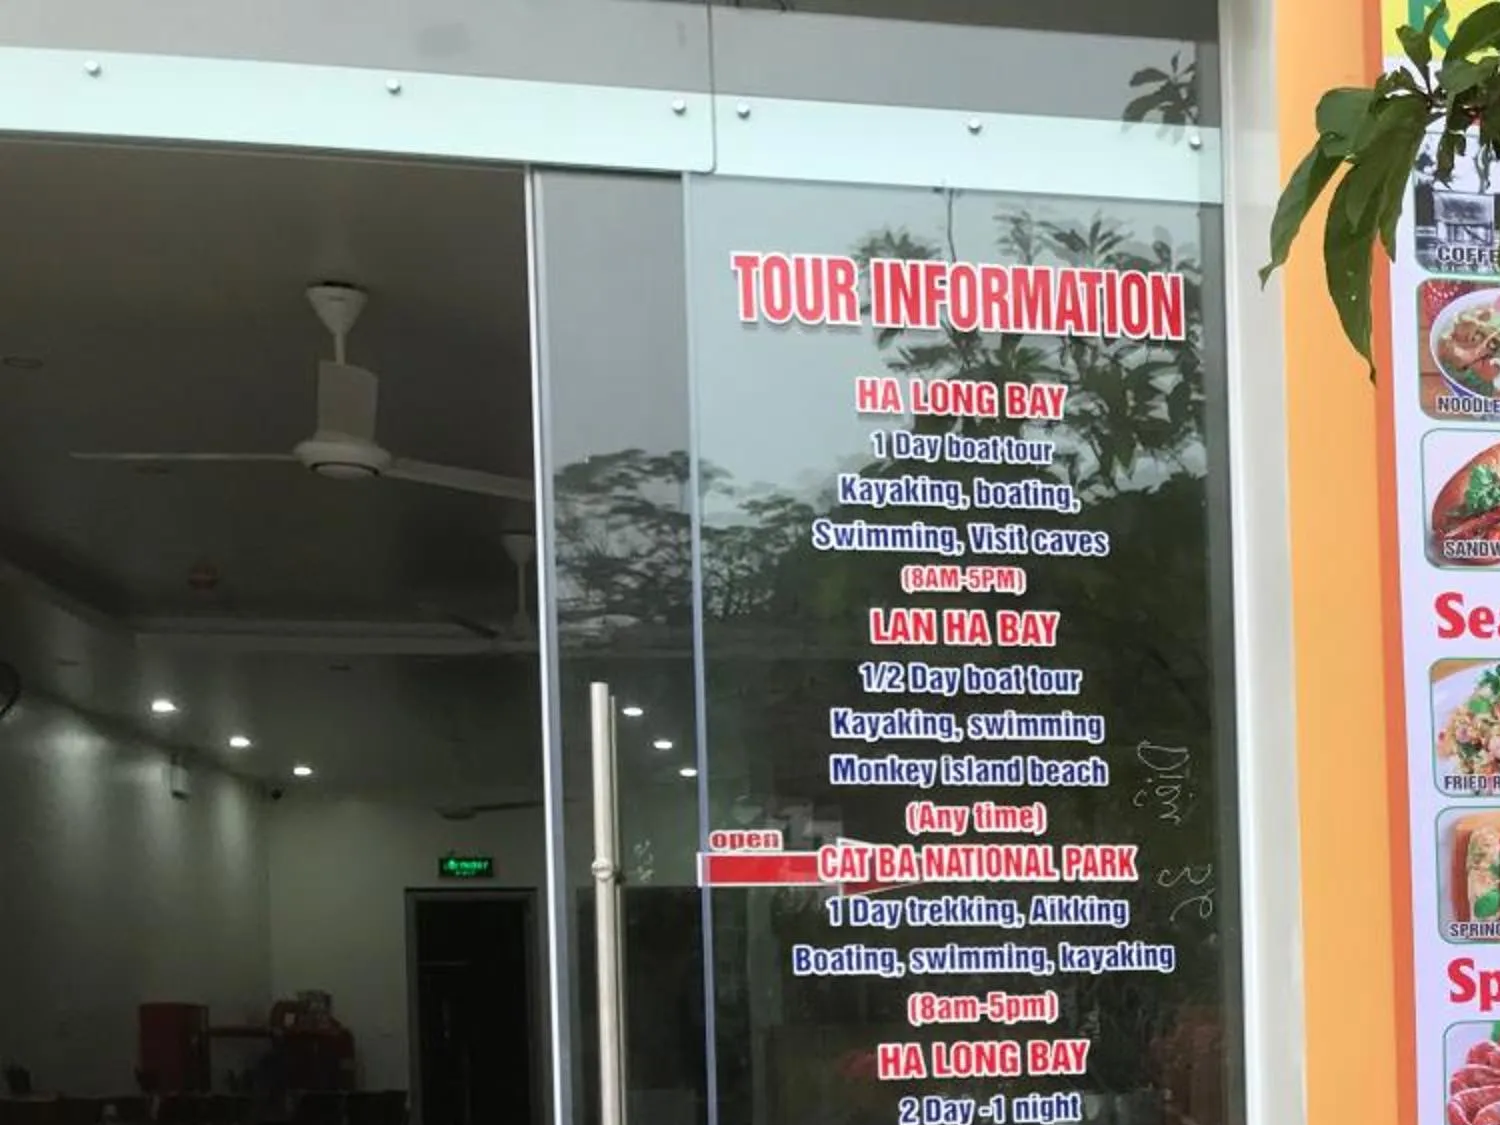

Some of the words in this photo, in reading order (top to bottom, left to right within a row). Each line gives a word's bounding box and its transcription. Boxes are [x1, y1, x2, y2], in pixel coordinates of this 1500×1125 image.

[1438, 245, 1500, 263] COFFE
[731, 252, 860, 324] TOUR
[871, 259, 1186, 340] INFORMATION
[857, 378, 901, 412] HA
[912, 380, 996, 415] LONG
[1006, 383, 1067, 418] BAY
[873, 433, 885, 456] 1
[894, 433, 942, 464] Day
[947, 434, 1001, 462] boat
[1005, 437, 1053, 463] tour
[839, 475, 969, 509] Kayaking,
[976, 478, 1080, 511] boating,
[812, 521, 963, 555] Swimming,
[967, 525, 1028, 553] Visit
[1033, 529, 1109, 555] caves
[901, 566, 1026, 594] (8AM-5PM)
[870, 609, 935, 644] LAN
[943, 611, 991, 645] HA
[999, 611, 1060, 646] BAY
[859, 663, 905, 691] 1/2
[911, 665, 963, 695] Day
[965, 667, 1025, 693] boat
[1028, 668, 1081, 693] tour
[830, 709, 964, 742] Kayaking,
[967, 712, 1104, 741] swimming
[830, 756, 934, 787] Monkey
[942, 757, 1021, 785] island
[1029, 758, 1108, 785] beach
[1445, 775, 1488, 789] FRIED
[907, 803, 967, 835] (Any
[974, 803, 1046, 832] time)
[709, 830, 782, 853] open
[817, 846, 872, 881] CAT
[878, 847, 918, 881] BA
[921, 847, 1058, 880] NATIONAL
[1063, 847, 1139, 880] PARK
[829, 900, 840, 925] 1
[852, 899, 901, 928] Day
[907, 897, 1025, 928] trekking,
[1031, 896, 1129, 927] Aikking
[792, 945, 905, 977] Boating,
[910, 944, 1055, 976] swimming,
[1058, 942, 1174, 973] kayaking
[908, 992, 1058, 1025] (8am-5pm)
[878, 1044, 926, 1079] HA
[932, 1042, 1020, 1077] LONG
[1027, 1040, 1091, 1073] BAY
[899, 1099, 919, 1124] 2
[1013, 1094, 1081, 1124] night
